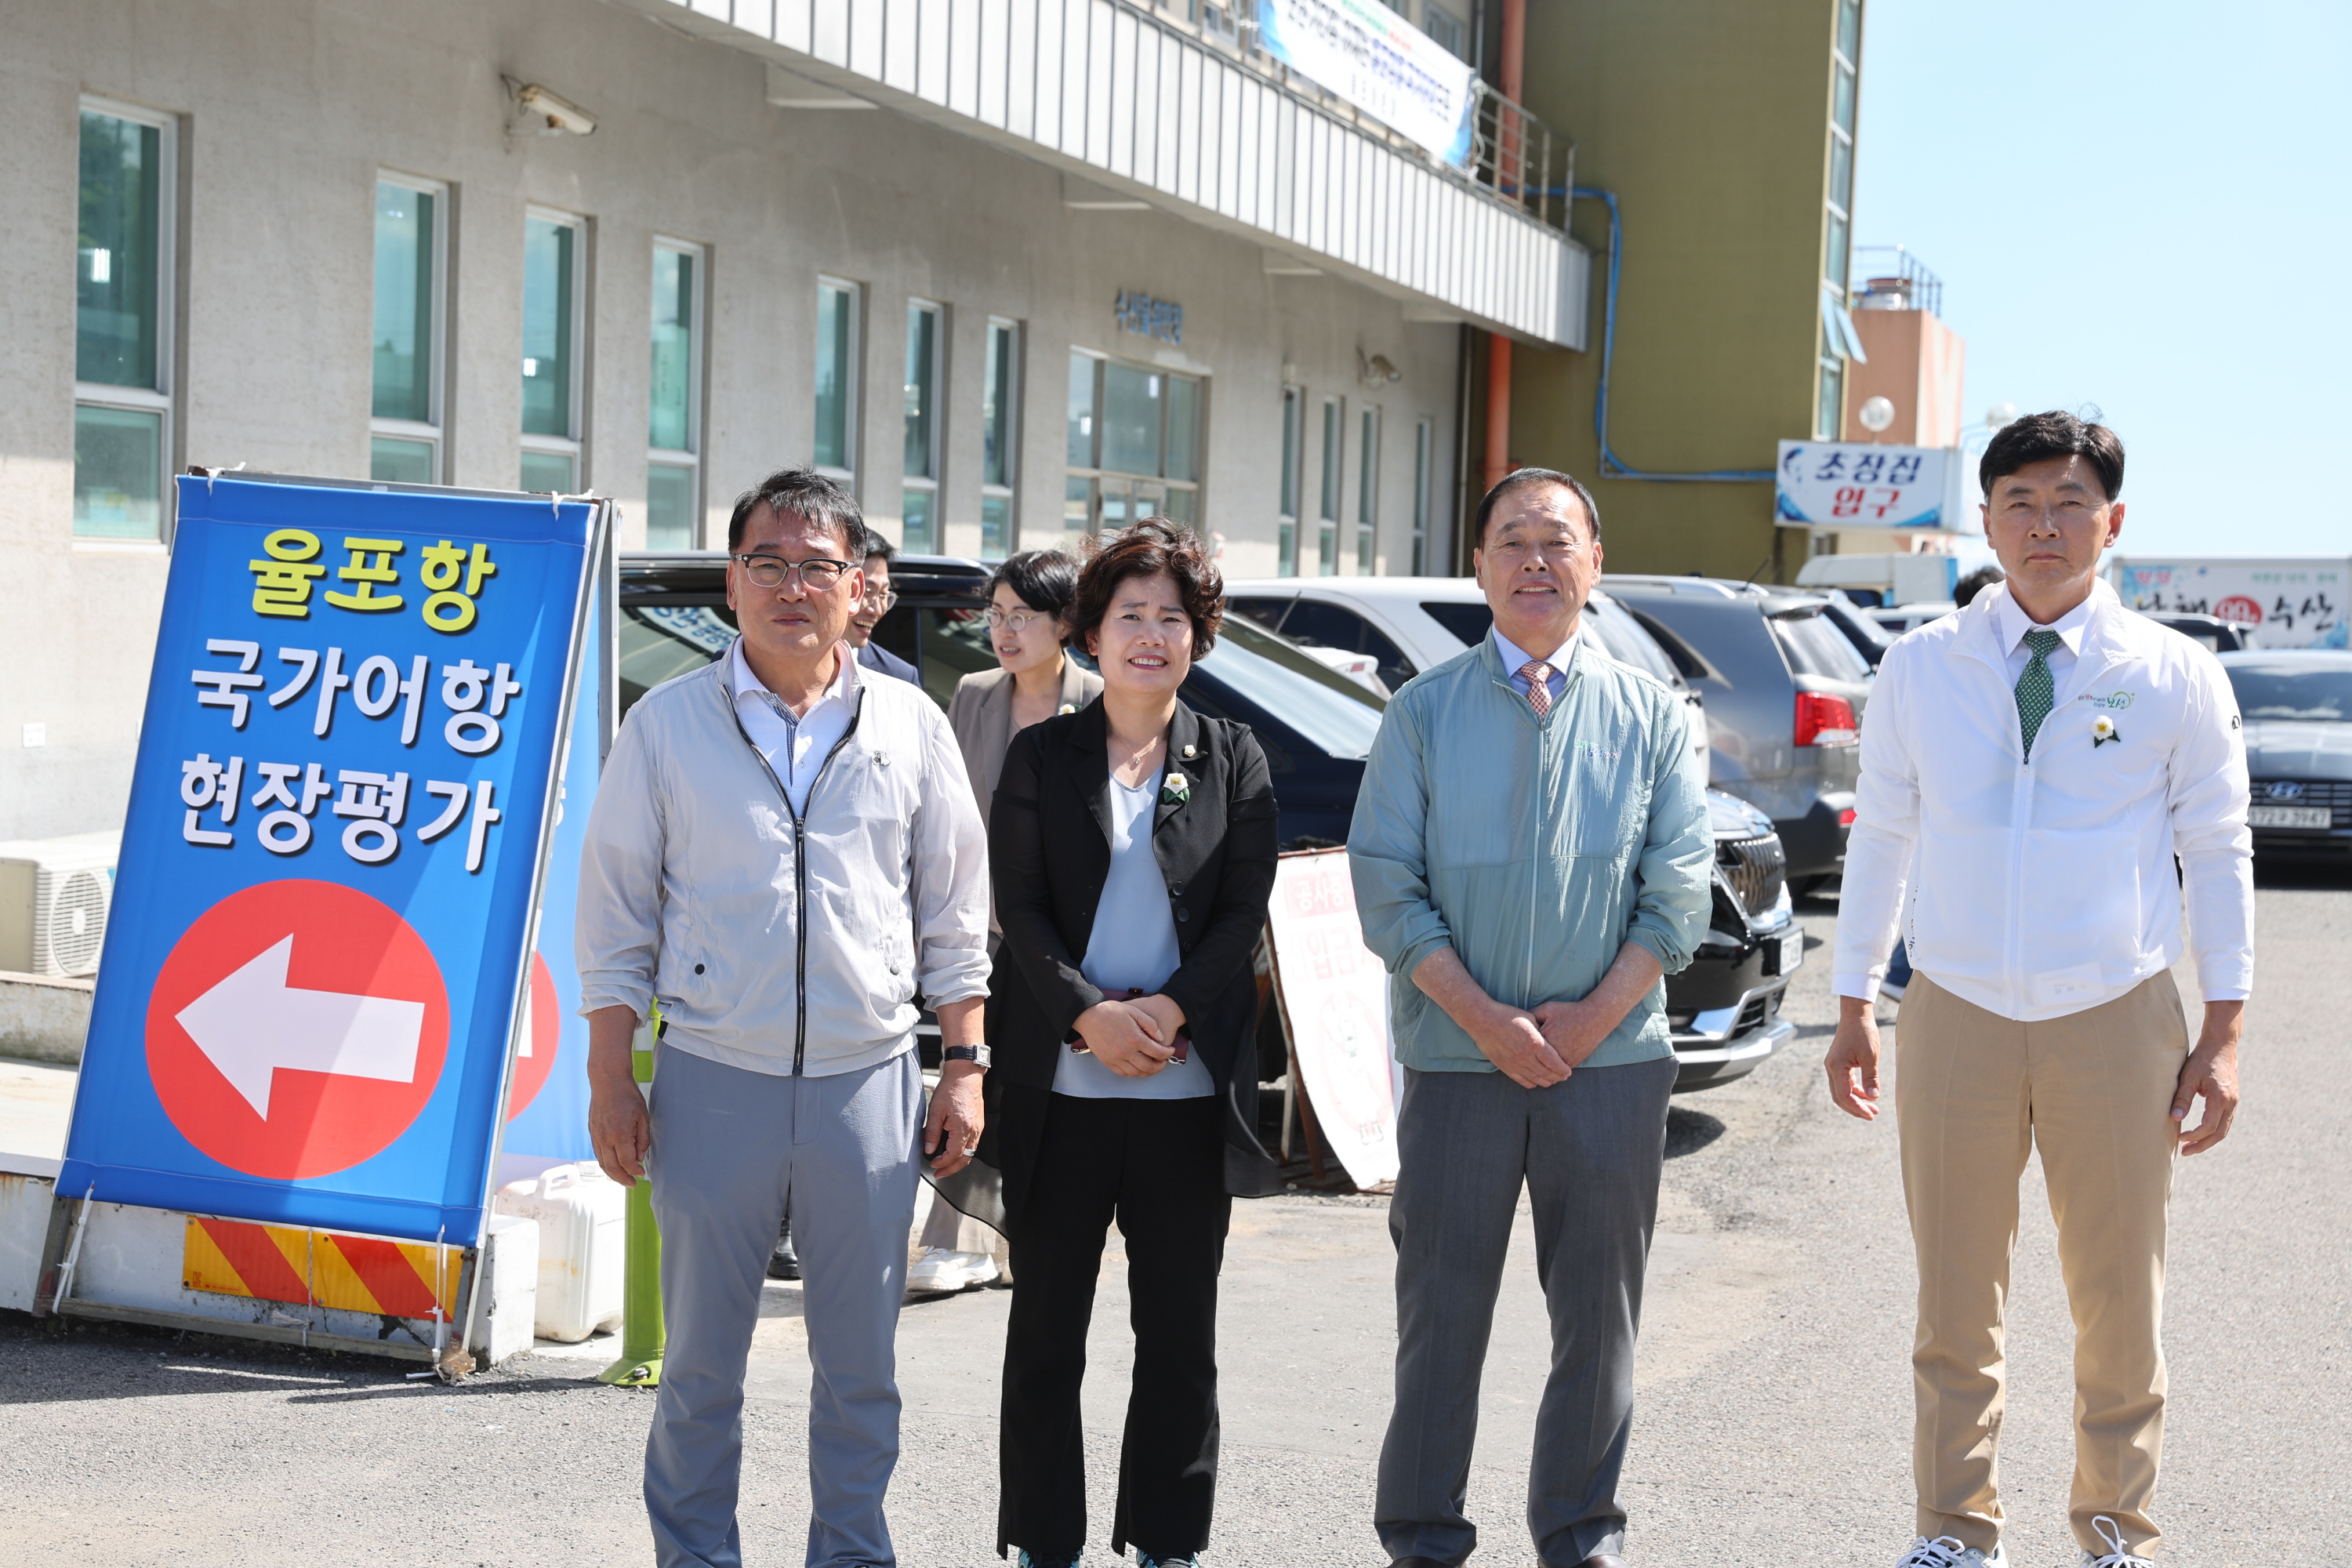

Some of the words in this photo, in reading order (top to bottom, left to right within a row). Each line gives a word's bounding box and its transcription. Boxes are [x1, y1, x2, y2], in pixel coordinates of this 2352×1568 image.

[1815, 450, 1923, 485] 초장집
[1831, 485, 1901, 518] 입구
[249, 528, 495, 631] 율포항
[191, 638, 521, 753] 국가어항
[180, 753, 500, 871] 현장평가
[1296, 876, 1345, 912] 공사중
